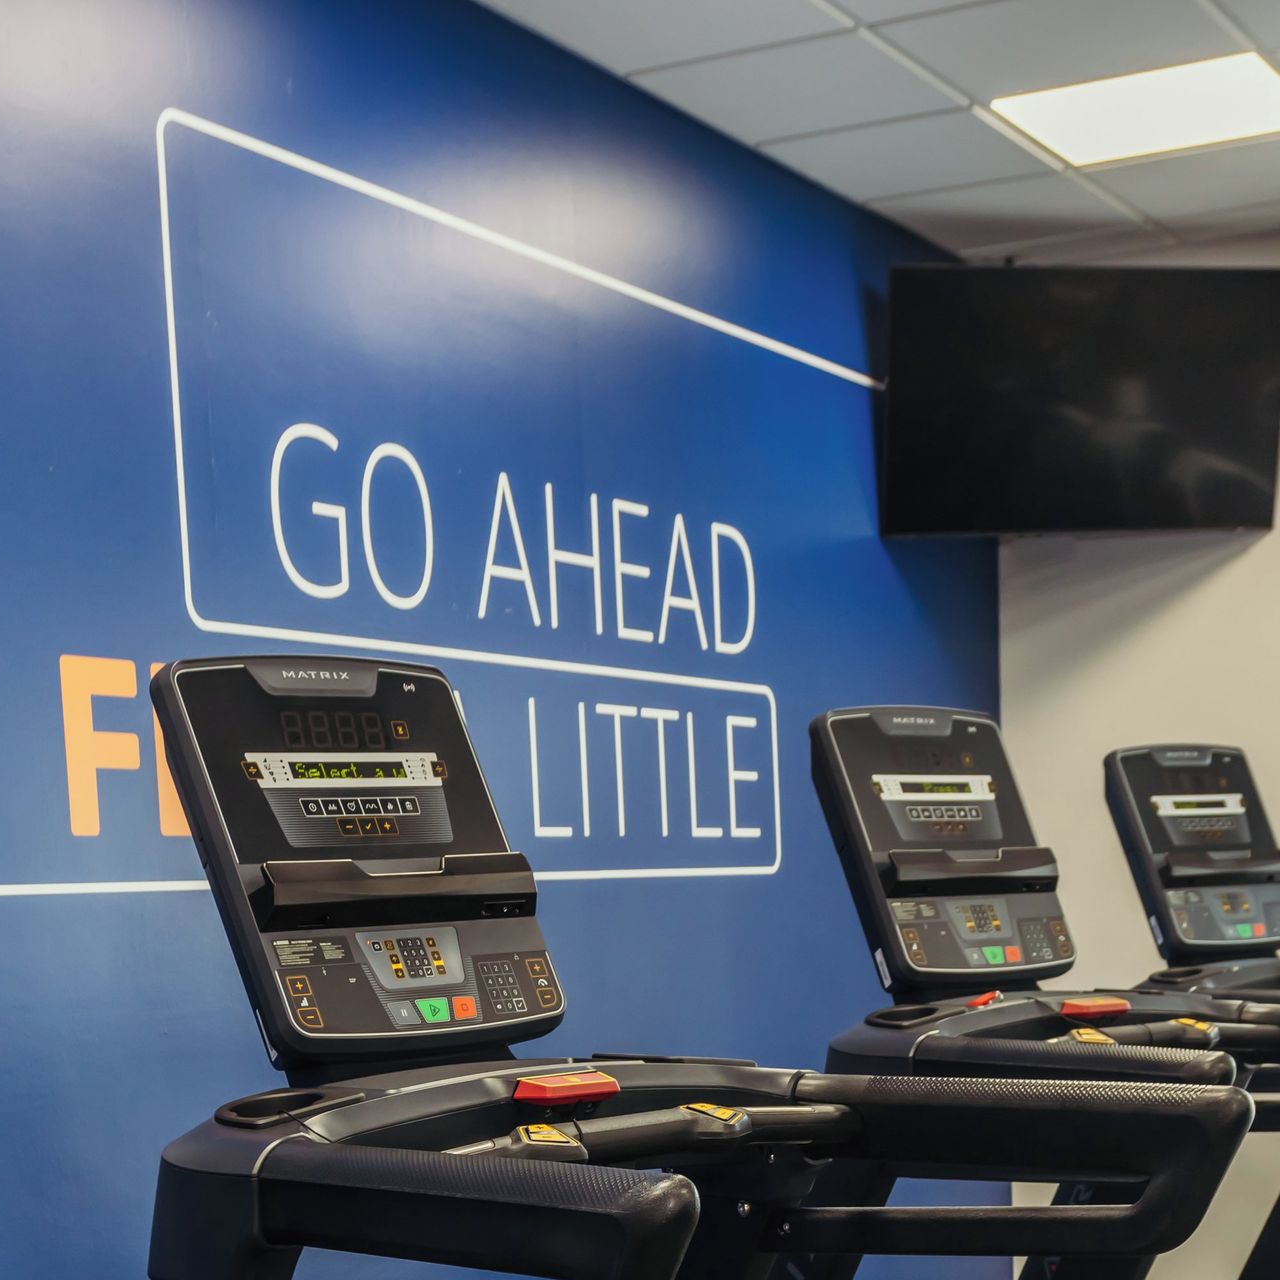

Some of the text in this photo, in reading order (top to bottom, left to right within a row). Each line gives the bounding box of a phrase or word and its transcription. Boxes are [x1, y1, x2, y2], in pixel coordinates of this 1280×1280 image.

[270, 422, 756, 655] GO AHEAD
[282, 670, 350, 680] MATRIX
[295, 762, 363, 779] Select
[528, 697, 761, 838] LITTLE
